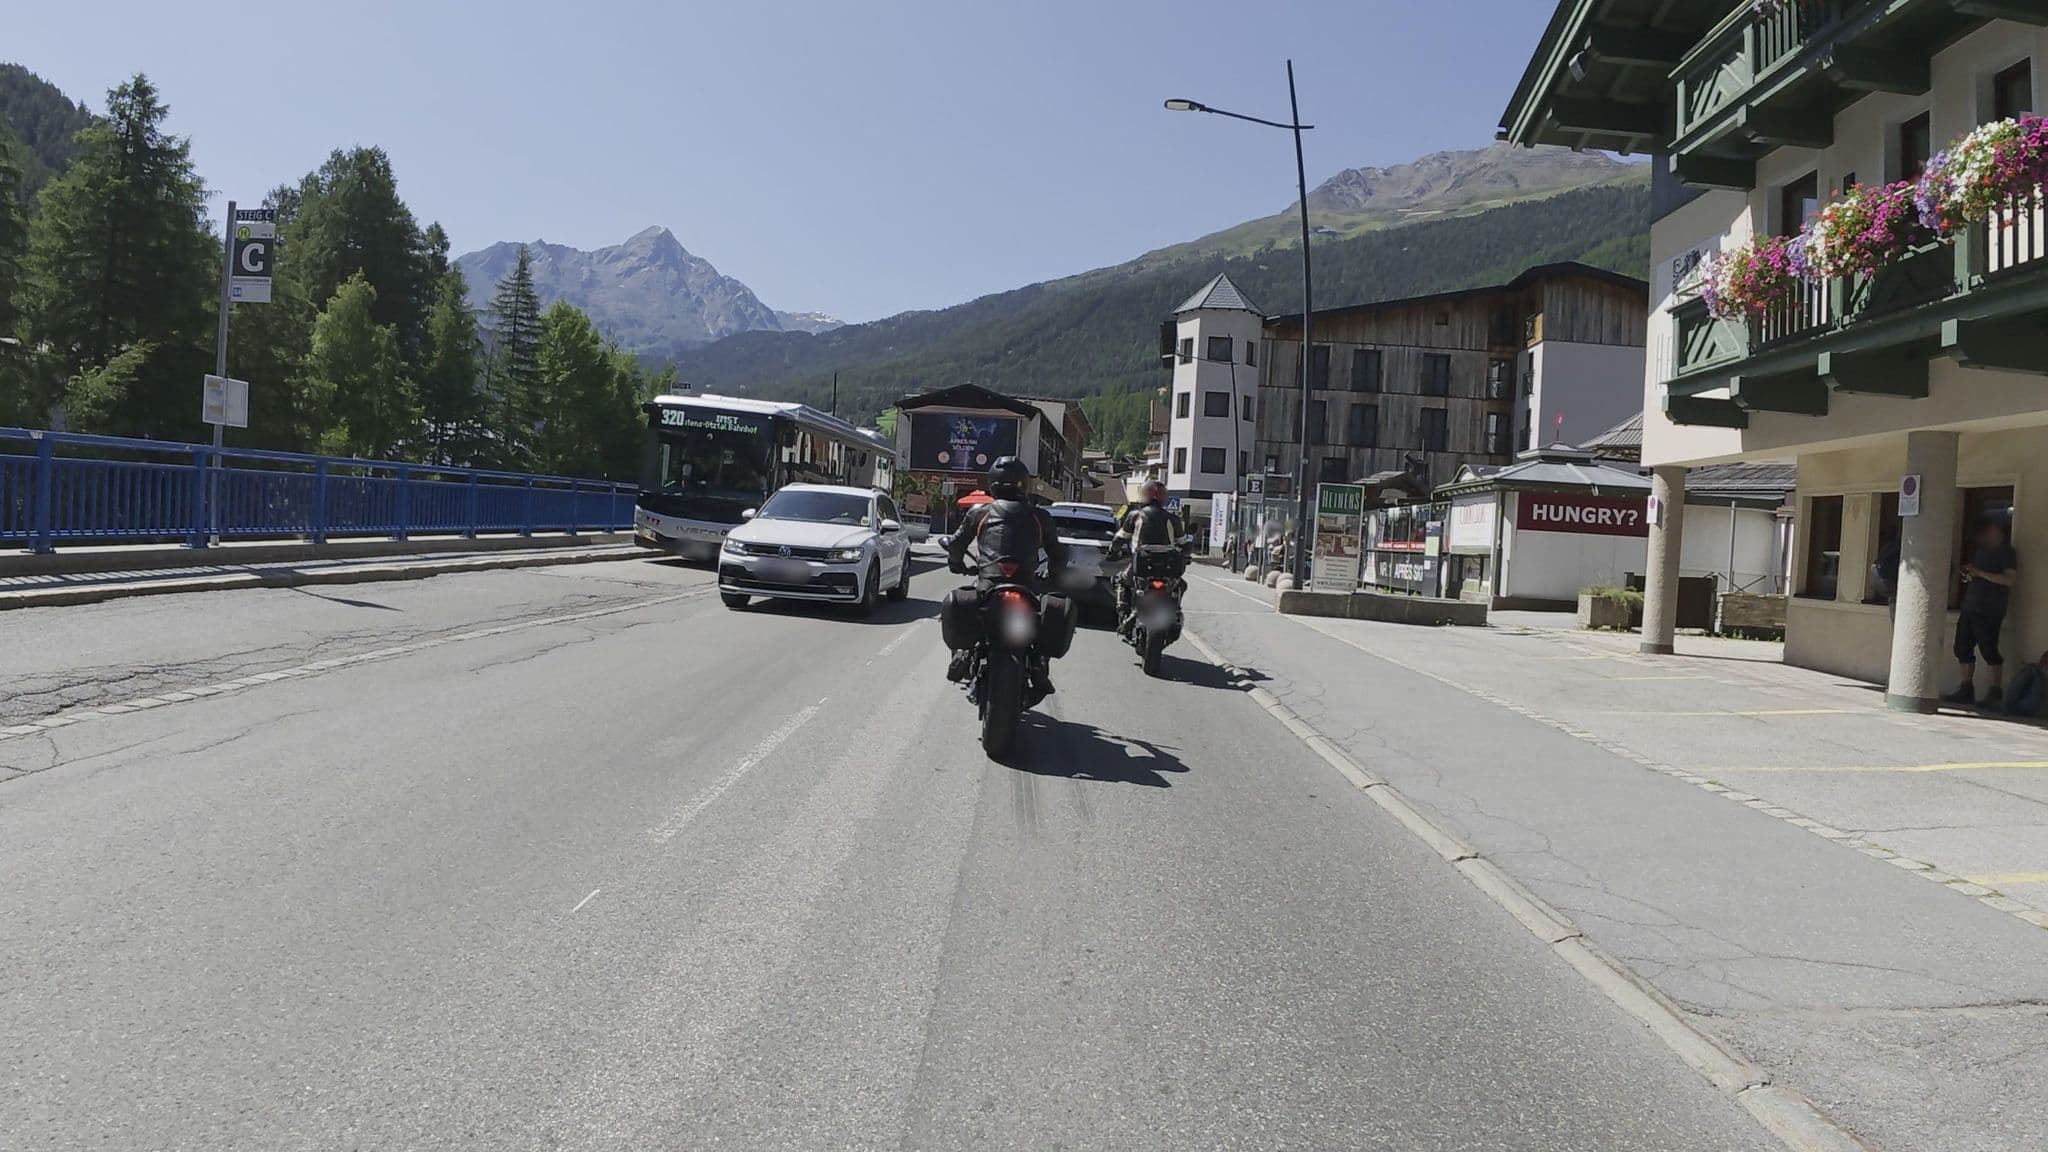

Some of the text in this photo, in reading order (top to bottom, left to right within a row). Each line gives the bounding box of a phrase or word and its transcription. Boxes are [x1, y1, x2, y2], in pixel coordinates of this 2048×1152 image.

[239, 211, 271, 220] STEIG C
[241, 242, 264, 271] C
[661, 408, 685, 426] 320
[1251, 481, 1260, 492] E
[1322, 490, 1360, 510] HEINERS
[1532, 503, 1639, 526] HUNGRY?
